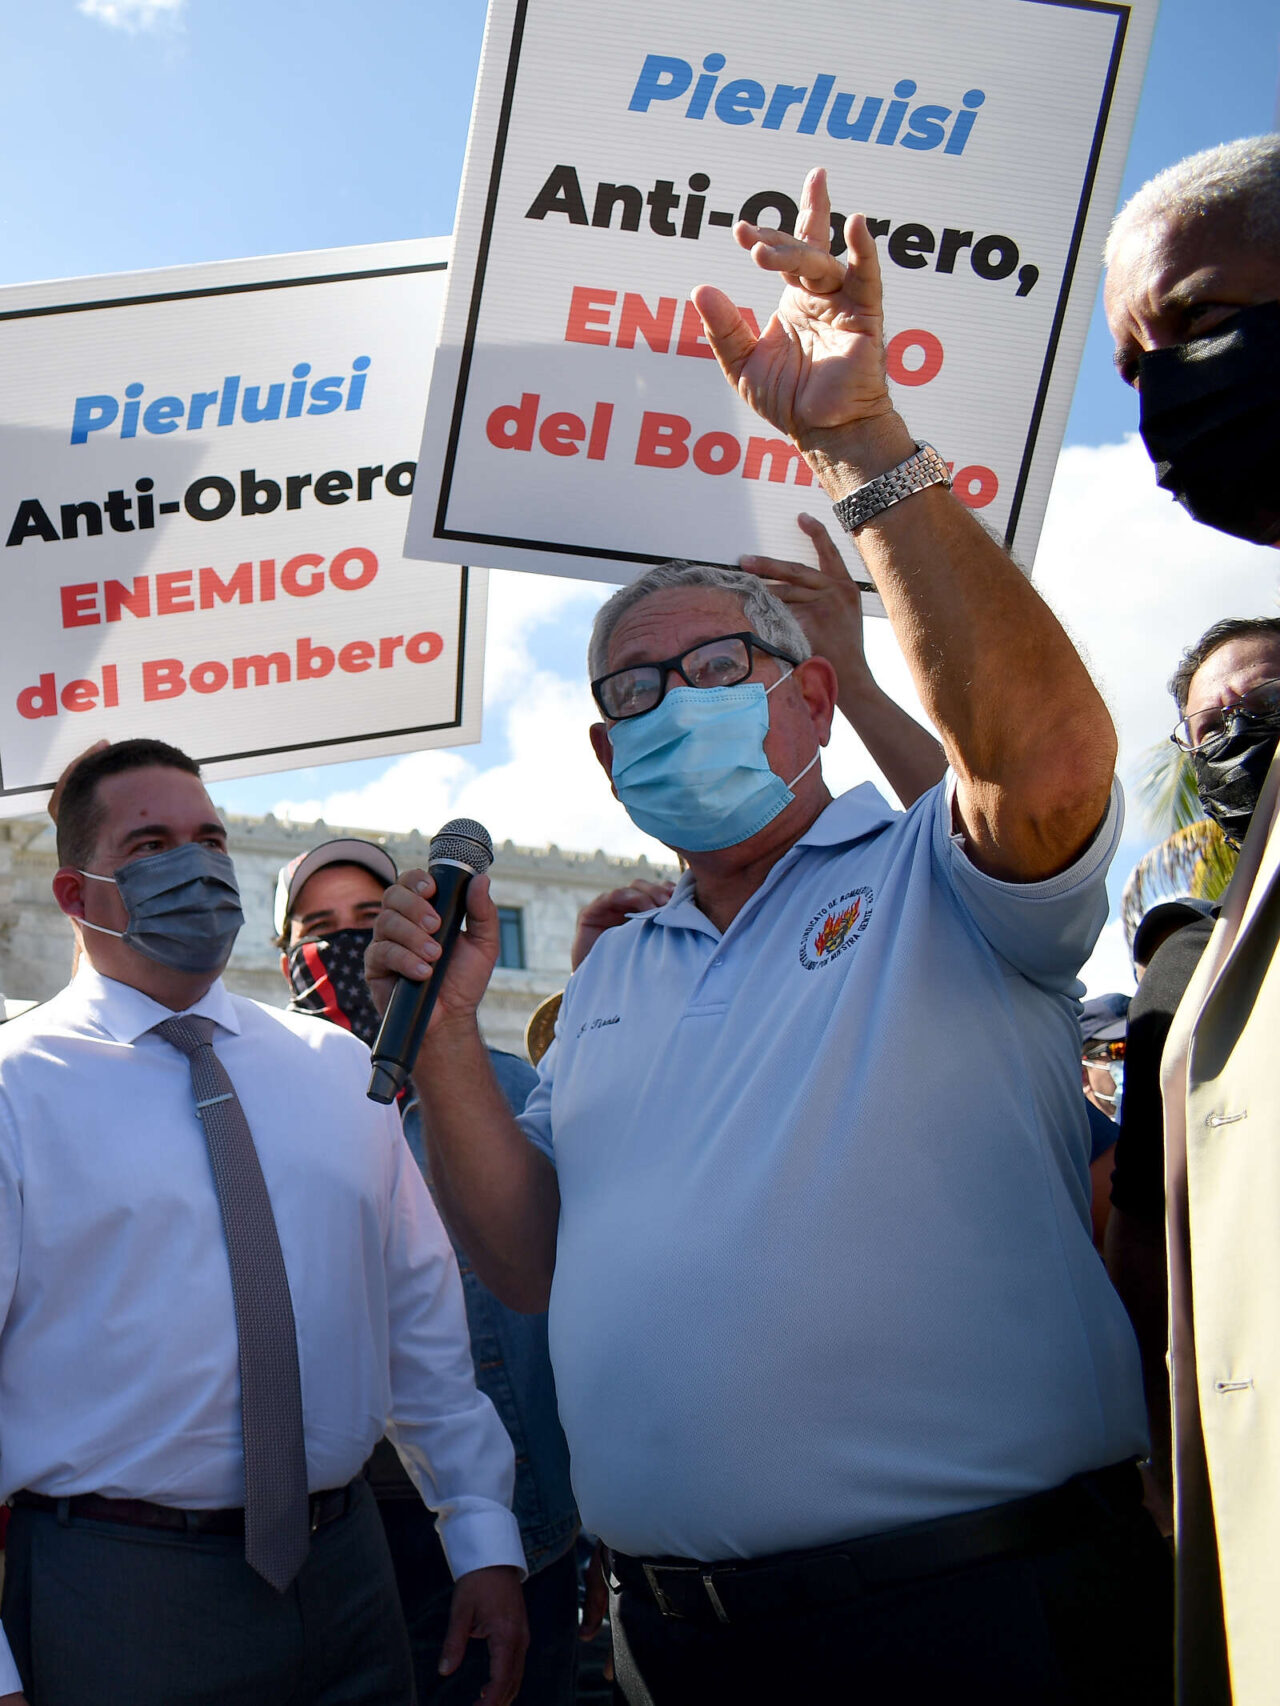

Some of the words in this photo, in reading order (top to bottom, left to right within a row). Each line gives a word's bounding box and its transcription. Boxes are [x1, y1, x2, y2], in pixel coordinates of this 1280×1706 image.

[627, 52, 986, 156] Pierluisi
[70, 355, 372, 445] Pierluisi
[485, 392, 615, 461] del
[634, 410, 999, 510] Bomo
[5, 461, 419, 547] Anti-Obrero
[59, 547, 379, 629] ENEMIGO
[16, 664, 119, 720] del
[142, 631, 444, 702] Bombero
